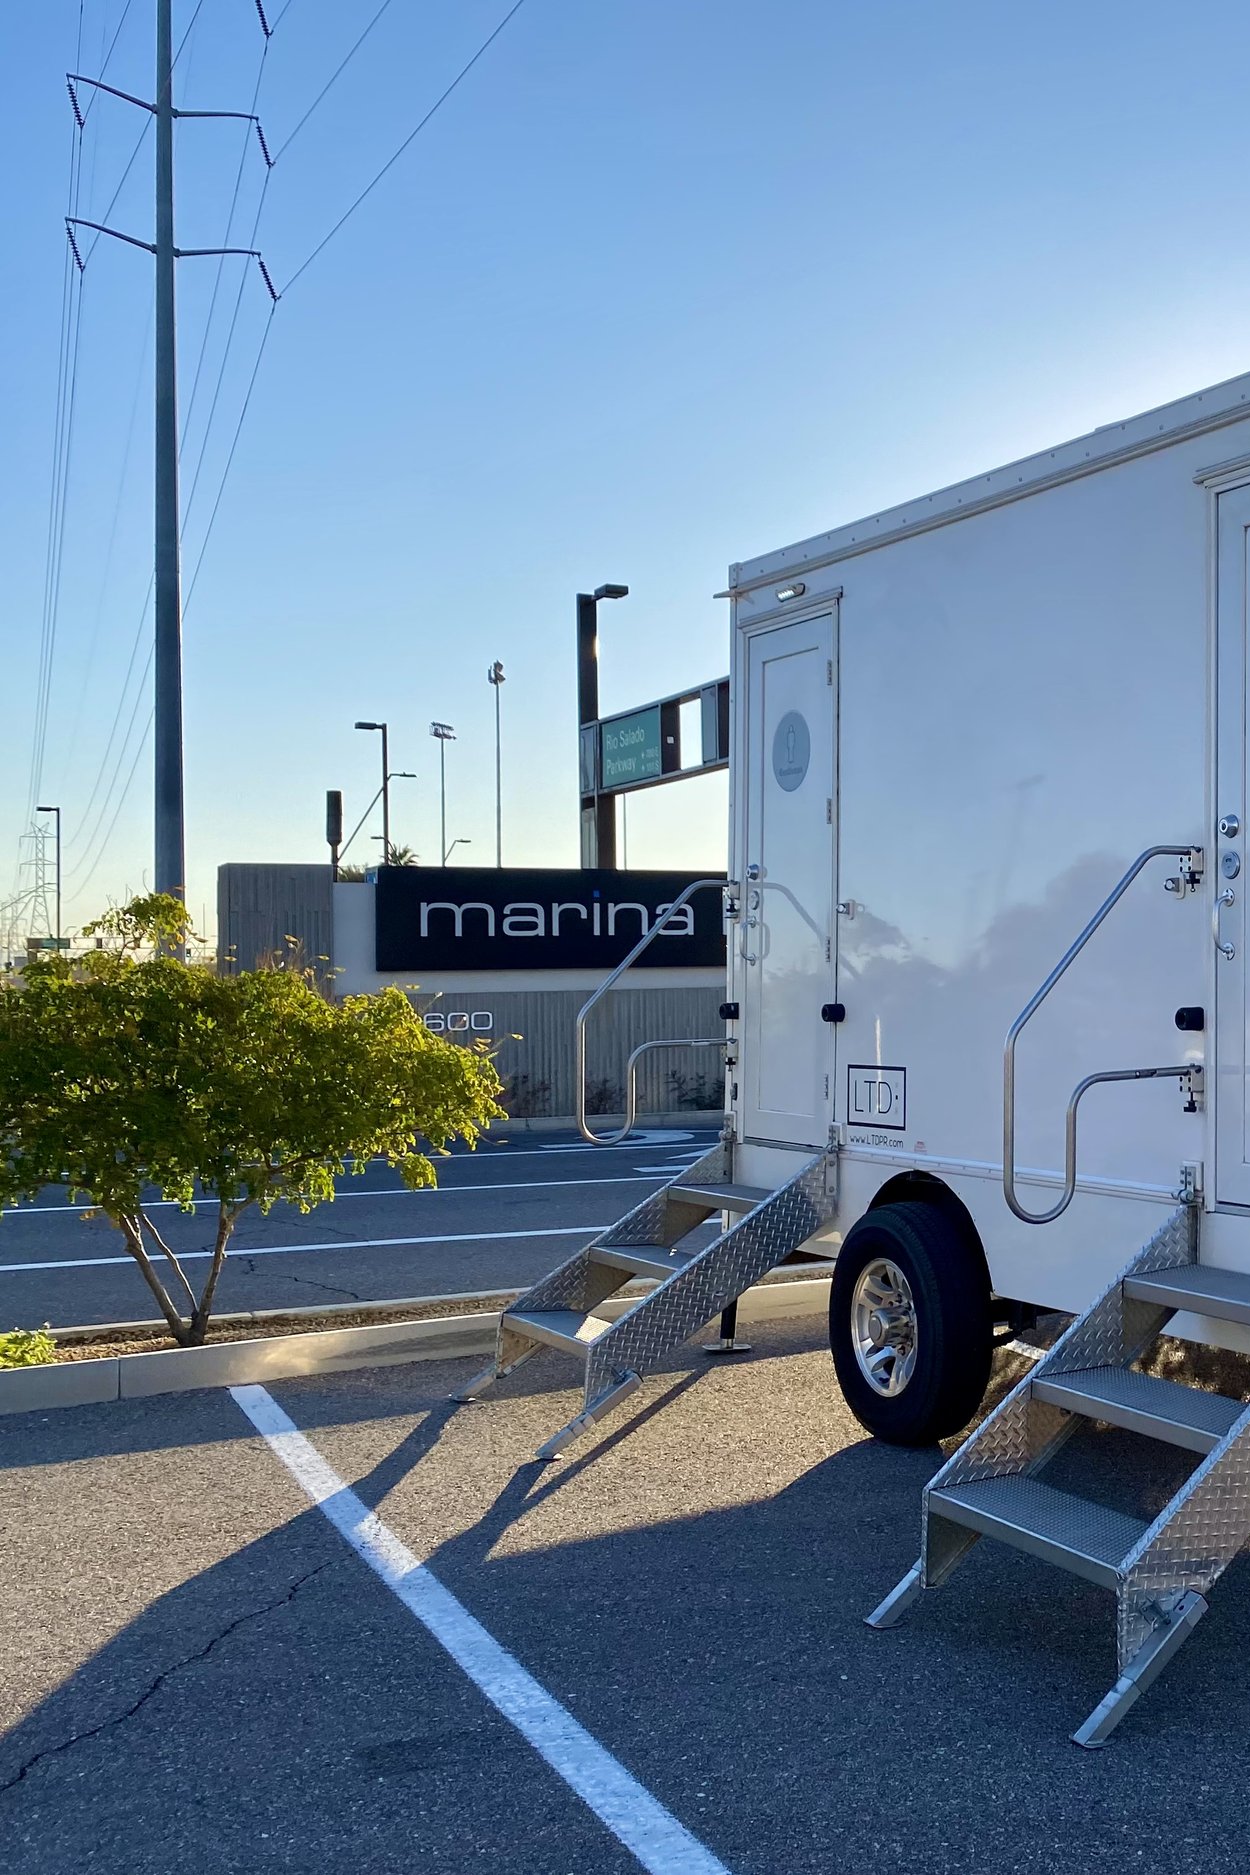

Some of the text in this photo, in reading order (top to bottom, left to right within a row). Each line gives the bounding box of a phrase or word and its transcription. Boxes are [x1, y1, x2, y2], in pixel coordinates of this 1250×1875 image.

[606, 725, 645, 751] Rio Salado
[606, 756, 637, 775] Parkway
[419, 890, 695, 937] marina
[423, 1011, 493, 1032] 600
[849, 1133, 904, 1149] www.LTDPR.com
